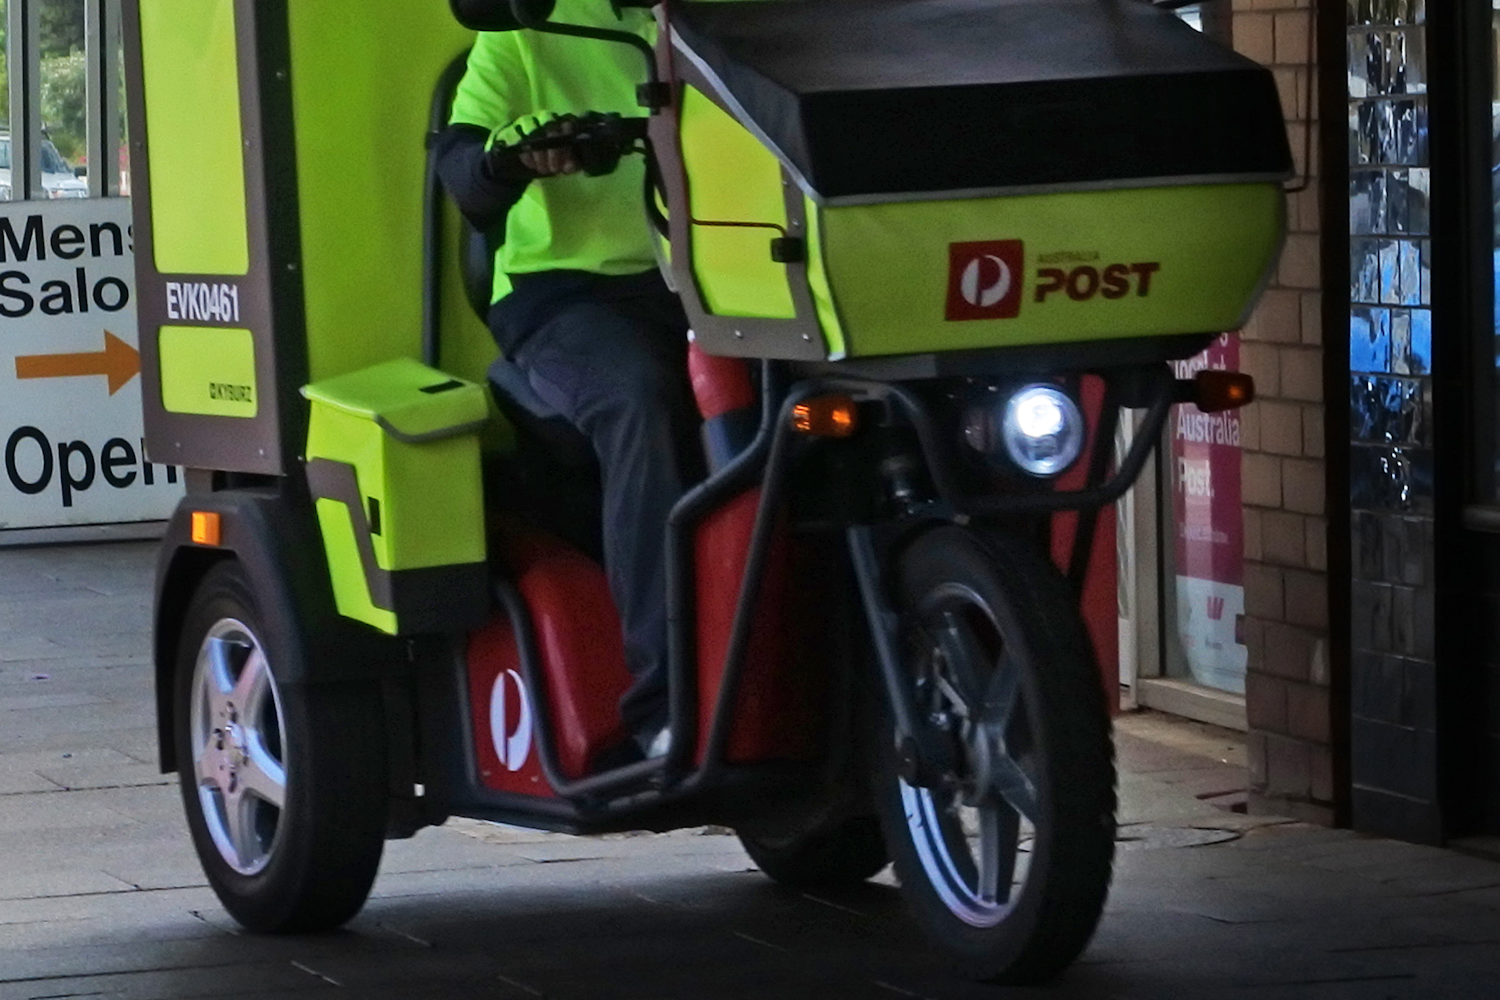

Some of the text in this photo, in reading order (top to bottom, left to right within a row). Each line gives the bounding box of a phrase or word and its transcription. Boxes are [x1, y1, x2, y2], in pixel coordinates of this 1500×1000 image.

[165, 281, 240, 322] EVK0461
[1033, 262, 1161, 303] POST
[1176, 403, 1241, 447] Australia
